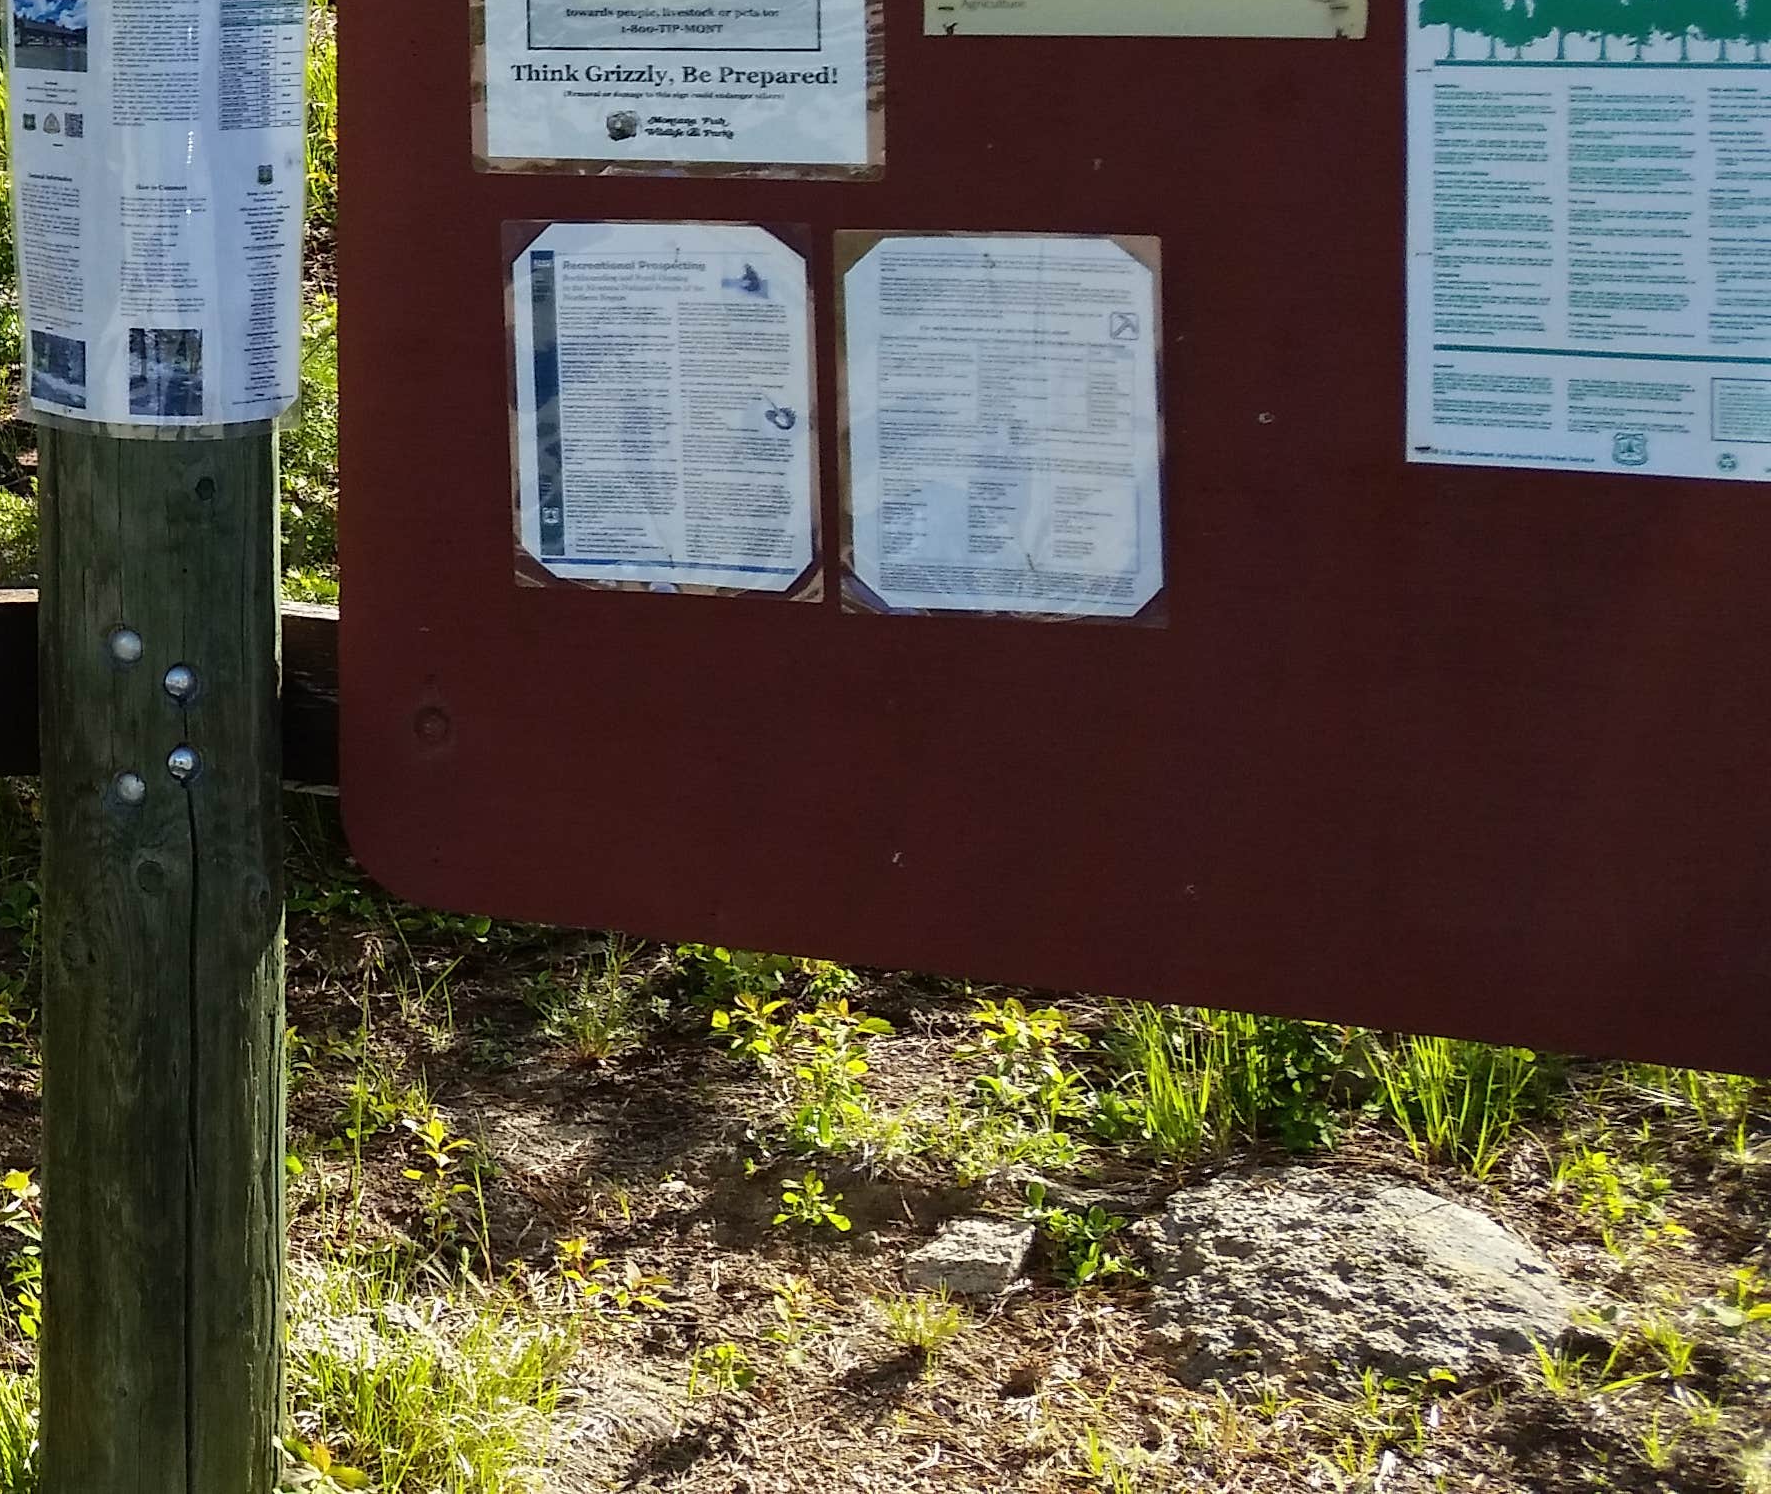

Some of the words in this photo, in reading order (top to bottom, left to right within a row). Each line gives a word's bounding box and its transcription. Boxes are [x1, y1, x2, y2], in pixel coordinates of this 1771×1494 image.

[511, 64, 579, 81] Think
[585, 65, 673, 86] Grizzly,
[682, 66, 711, 82] Be
[719, 67, 837, 88] Prepared!
